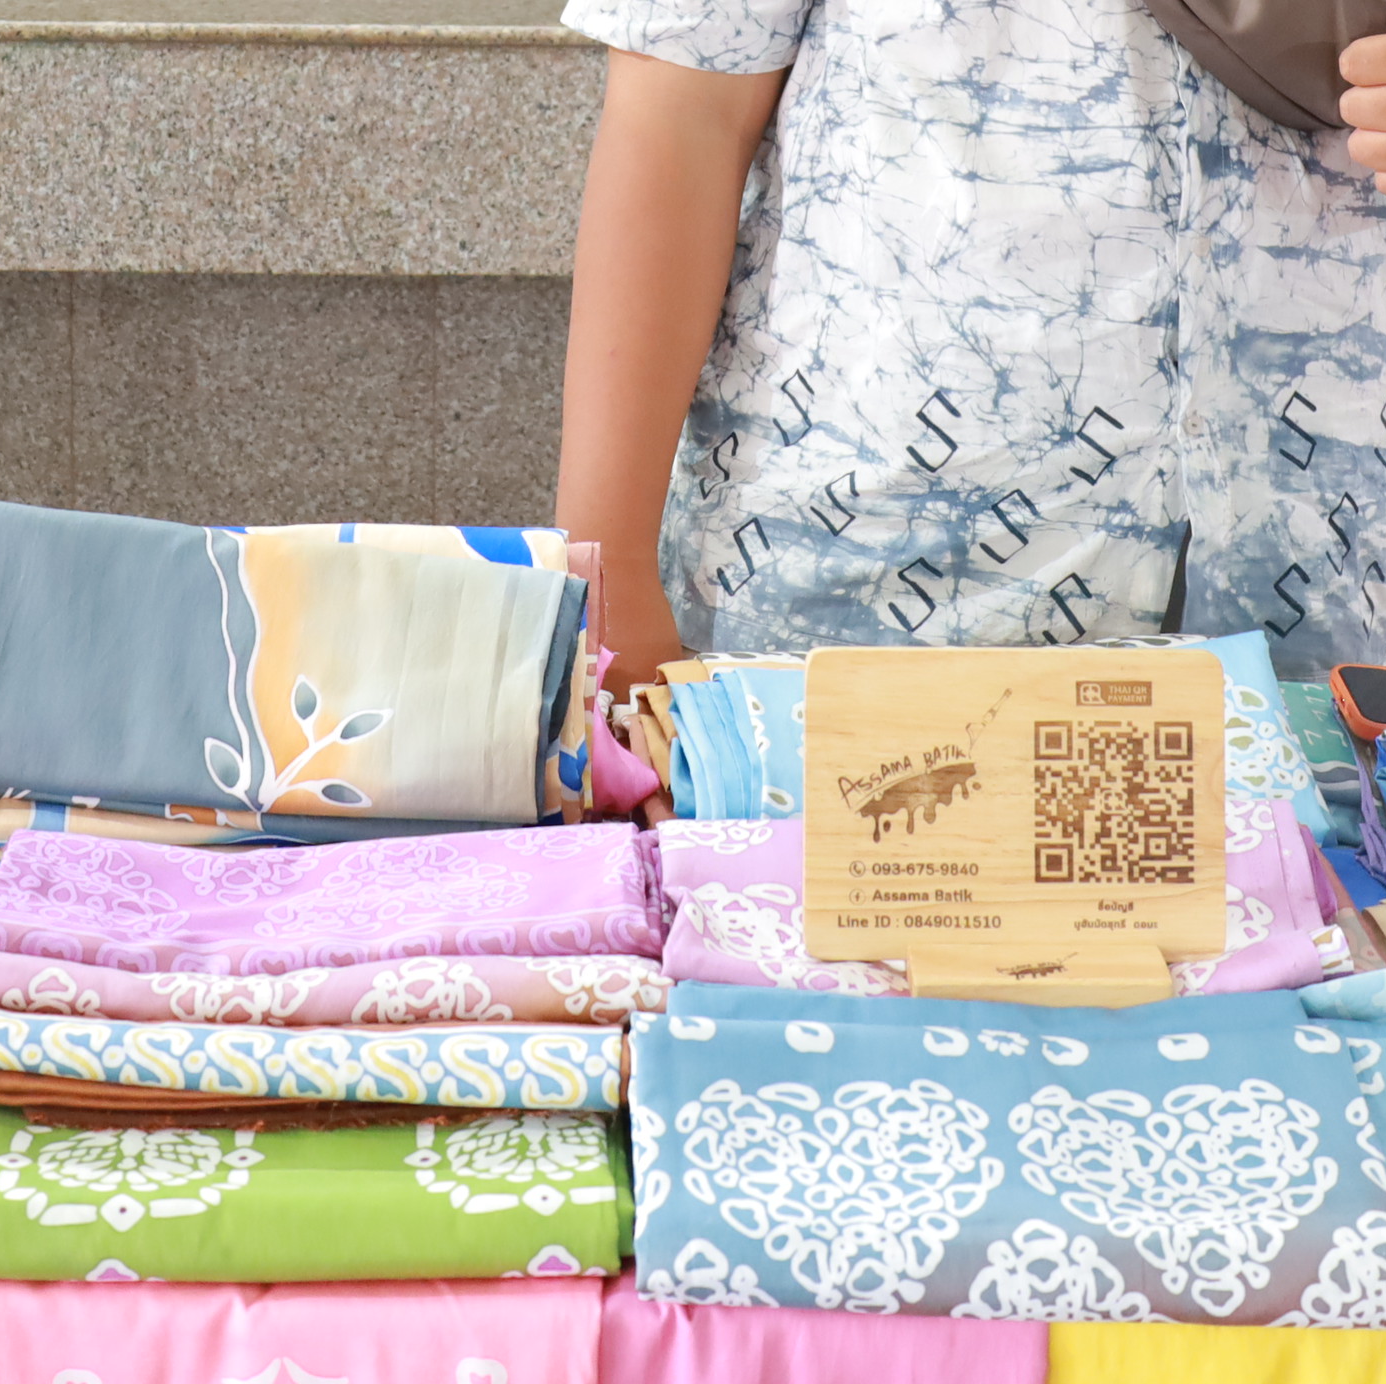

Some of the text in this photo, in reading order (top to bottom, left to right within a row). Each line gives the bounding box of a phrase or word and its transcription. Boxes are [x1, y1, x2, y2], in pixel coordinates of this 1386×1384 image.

[871, 862, 979, 876] 093-675-9840
[872, 888, 973, 902] Assama Batik
[837, 914, 869, 928] Line
[874, 915, 891, 928] ID
[904, 915, 1002, 928] 0849011510
